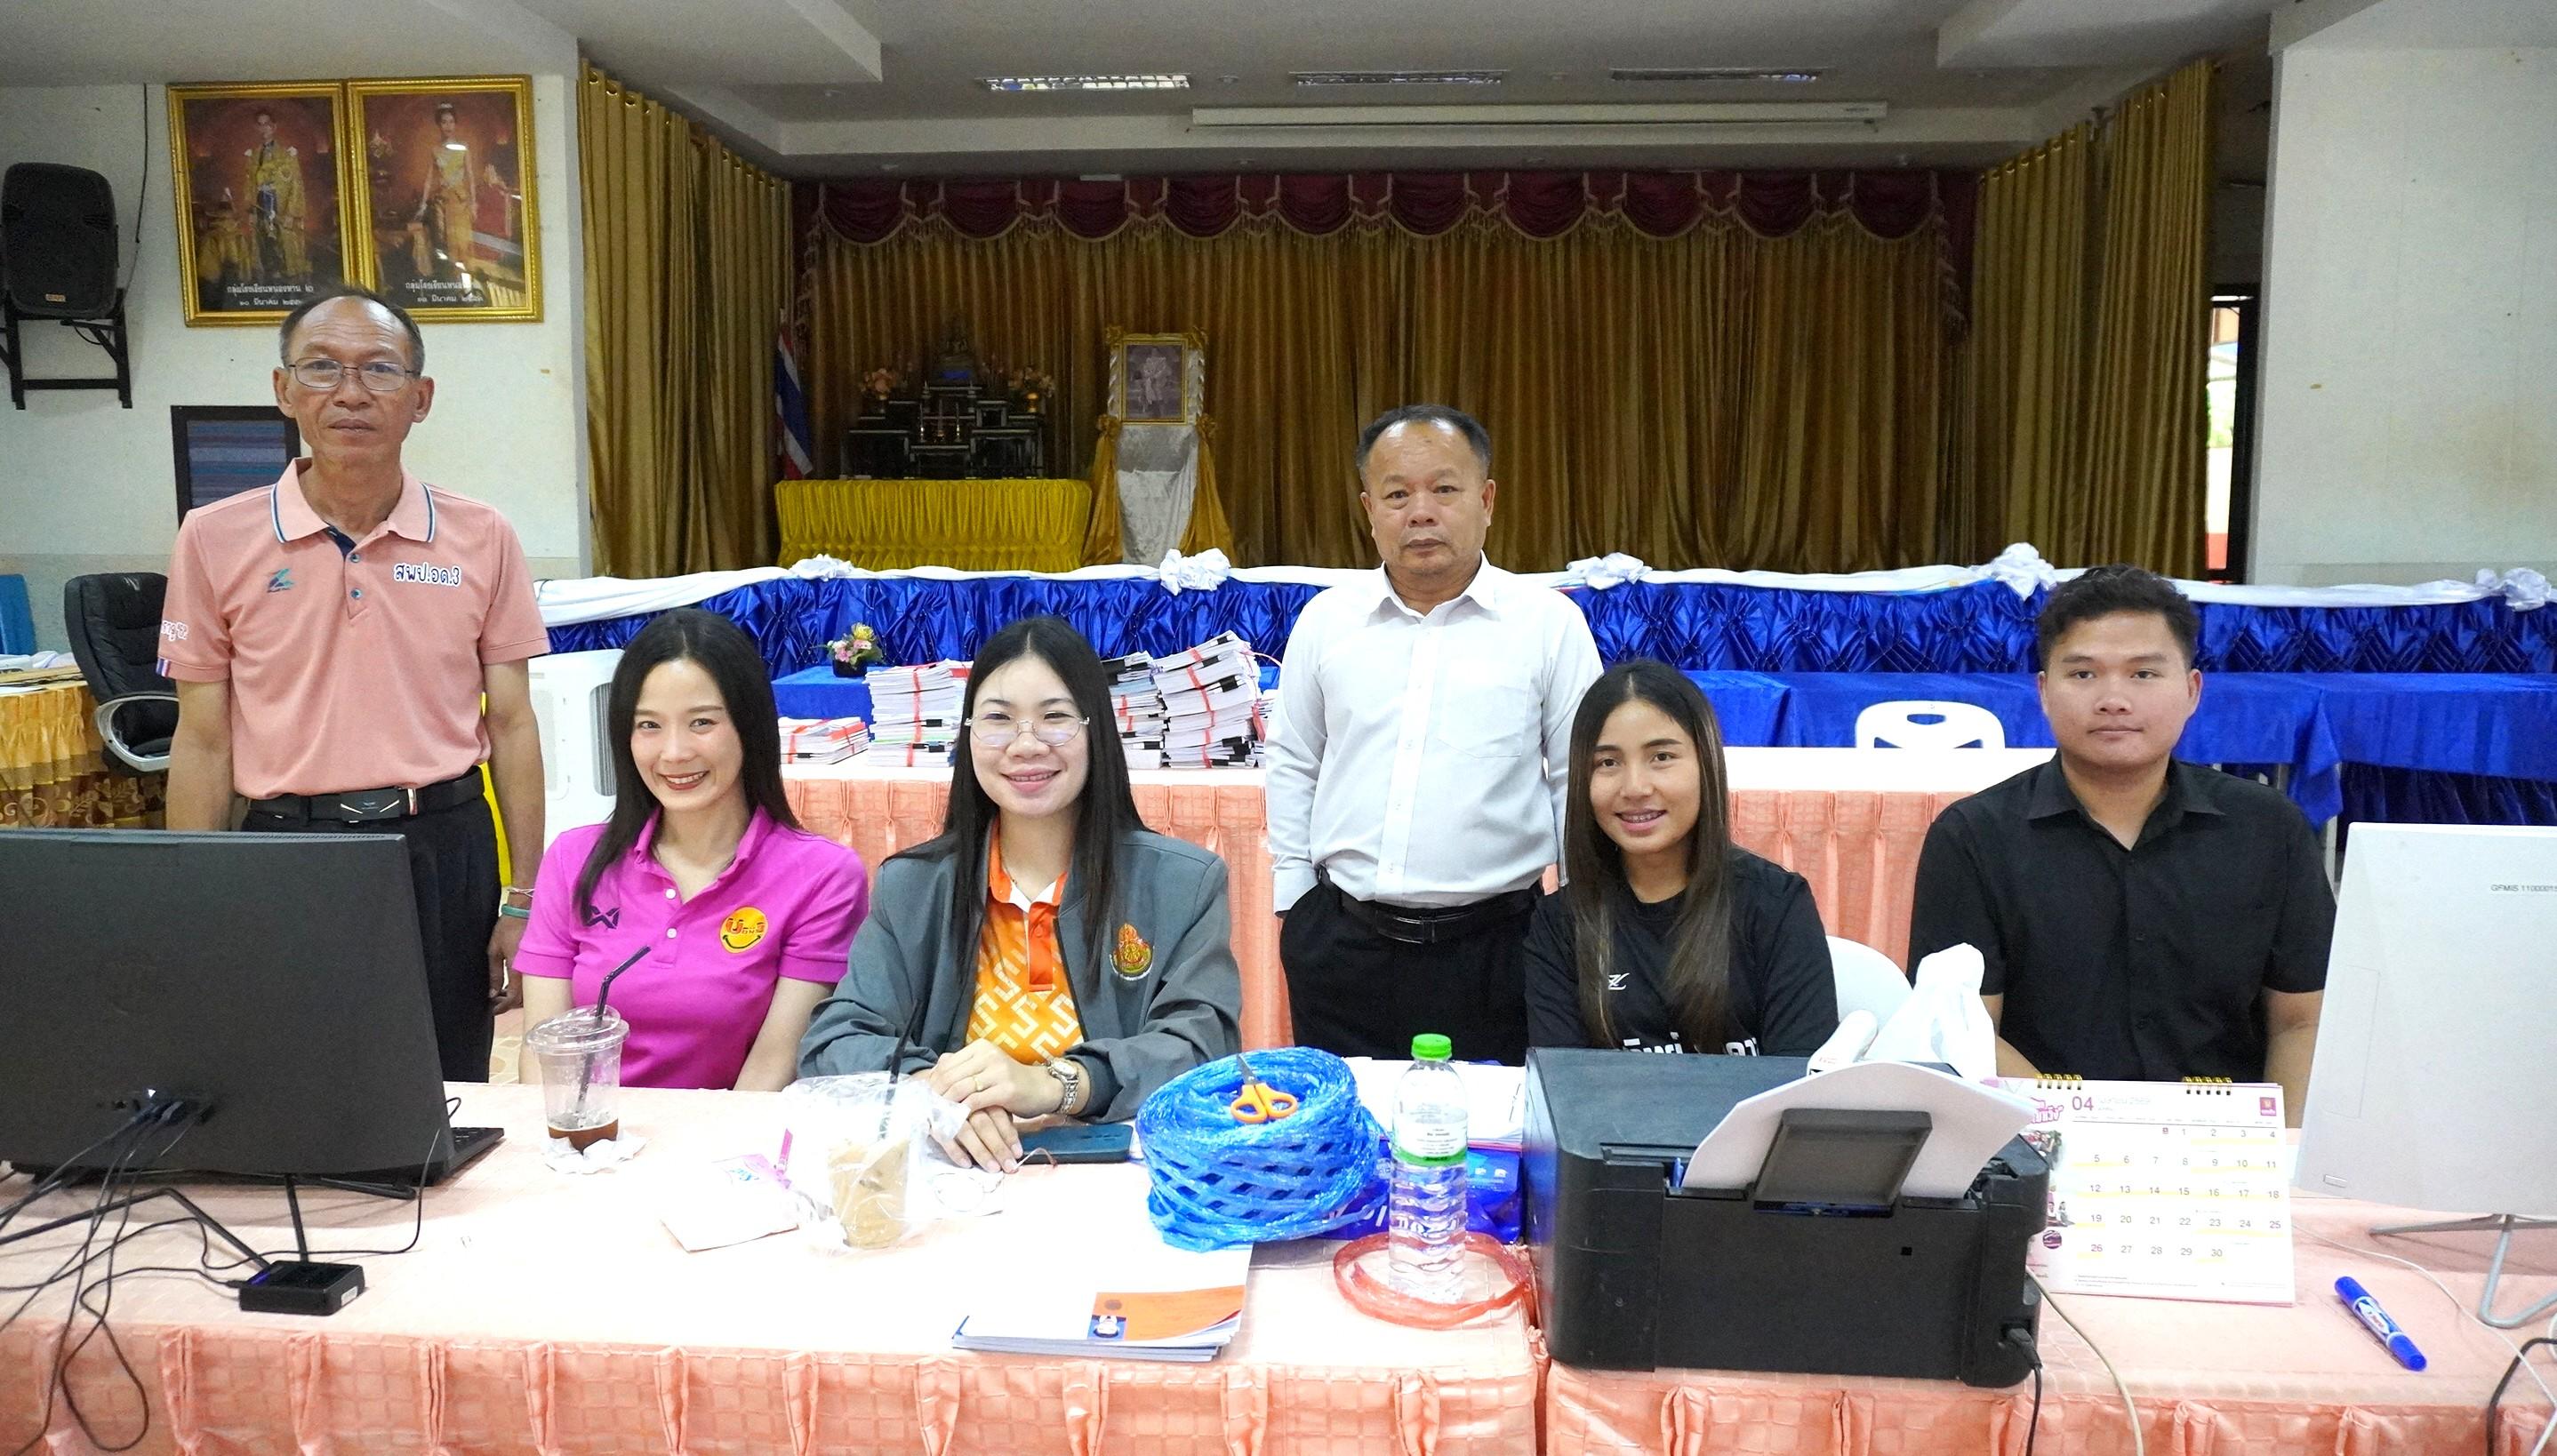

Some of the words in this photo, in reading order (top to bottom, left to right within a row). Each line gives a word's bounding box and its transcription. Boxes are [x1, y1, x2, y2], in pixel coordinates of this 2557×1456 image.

[395, 563, 461, 586] สพป.อด.3
[2072, 1095, 2095, 1112] 04
[2237, 1159, 2248, 1168] 10
[2266, 1160, 2276, 1169] 11
[2090, 1184, 2102, 1193] 12
[2120, 1185, 2131, 1194] 13
[2149, 1187, 2160, 1195] 14
[2178, 1187, 2190, 1196] 15
[2208, 1188, 2220, 1196] 16
[2239, 1188, 2249, 1197] 17
[2268, 1190, 2280, 1199] 18
[2090, 1213, 2103, 1223] 19
[2120, 1215, 2132, 1224] 20
[2149, 1216, 2160, 1225] 21
[2179, 1217, 2192, 1226] 22
[2209, 1218, 2222, 1227] 23
[2240, 1220, 2251, 1228] 24
[2269, 1220, 2281, 1229] 25
[2090, 1244, 2104, 1252] 26
[2120, 1244, 2133, 1253] 27
[2151, 1246, 2163, 1255] 28
[2180, 1247, 2192, 1256] 29
[2211, 1248, 2223, 1258] 30
